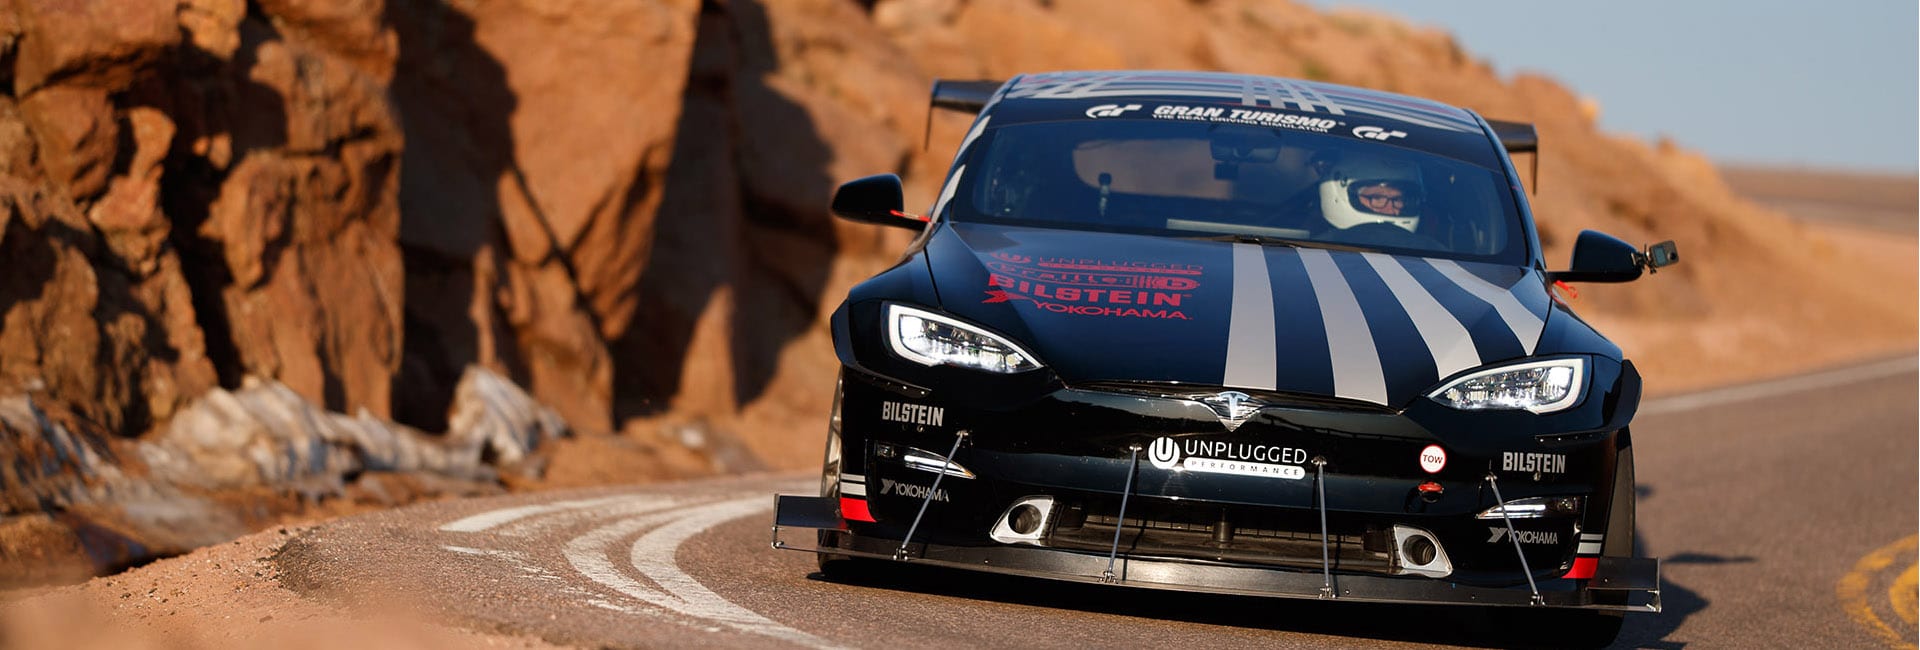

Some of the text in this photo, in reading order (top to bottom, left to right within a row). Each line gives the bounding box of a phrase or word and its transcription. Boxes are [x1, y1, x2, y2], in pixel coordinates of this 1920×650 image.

[1153, 105, 1337, 129] GRAN TURISMO
[1209, 117, 1258, 126] DRIVING
[1260, 121, 1329, 133] SIMULATOR
[1039, 256, 1203, 270] UNPLUGGED
[988, 273, 1182, 306] BILSTEIN
[1033, 299, 1188, 320] YOKOHAMA
[882, 400, 944, 427] BILSTEIN
[1185, 439, 1307, 464] UNPLUGGED
[1422, 454, 1444, 464] TOW
[1502, 451, 1566, 474] BILSTEIN
[1190, 460, 1300, 476] PERFORMANCE
